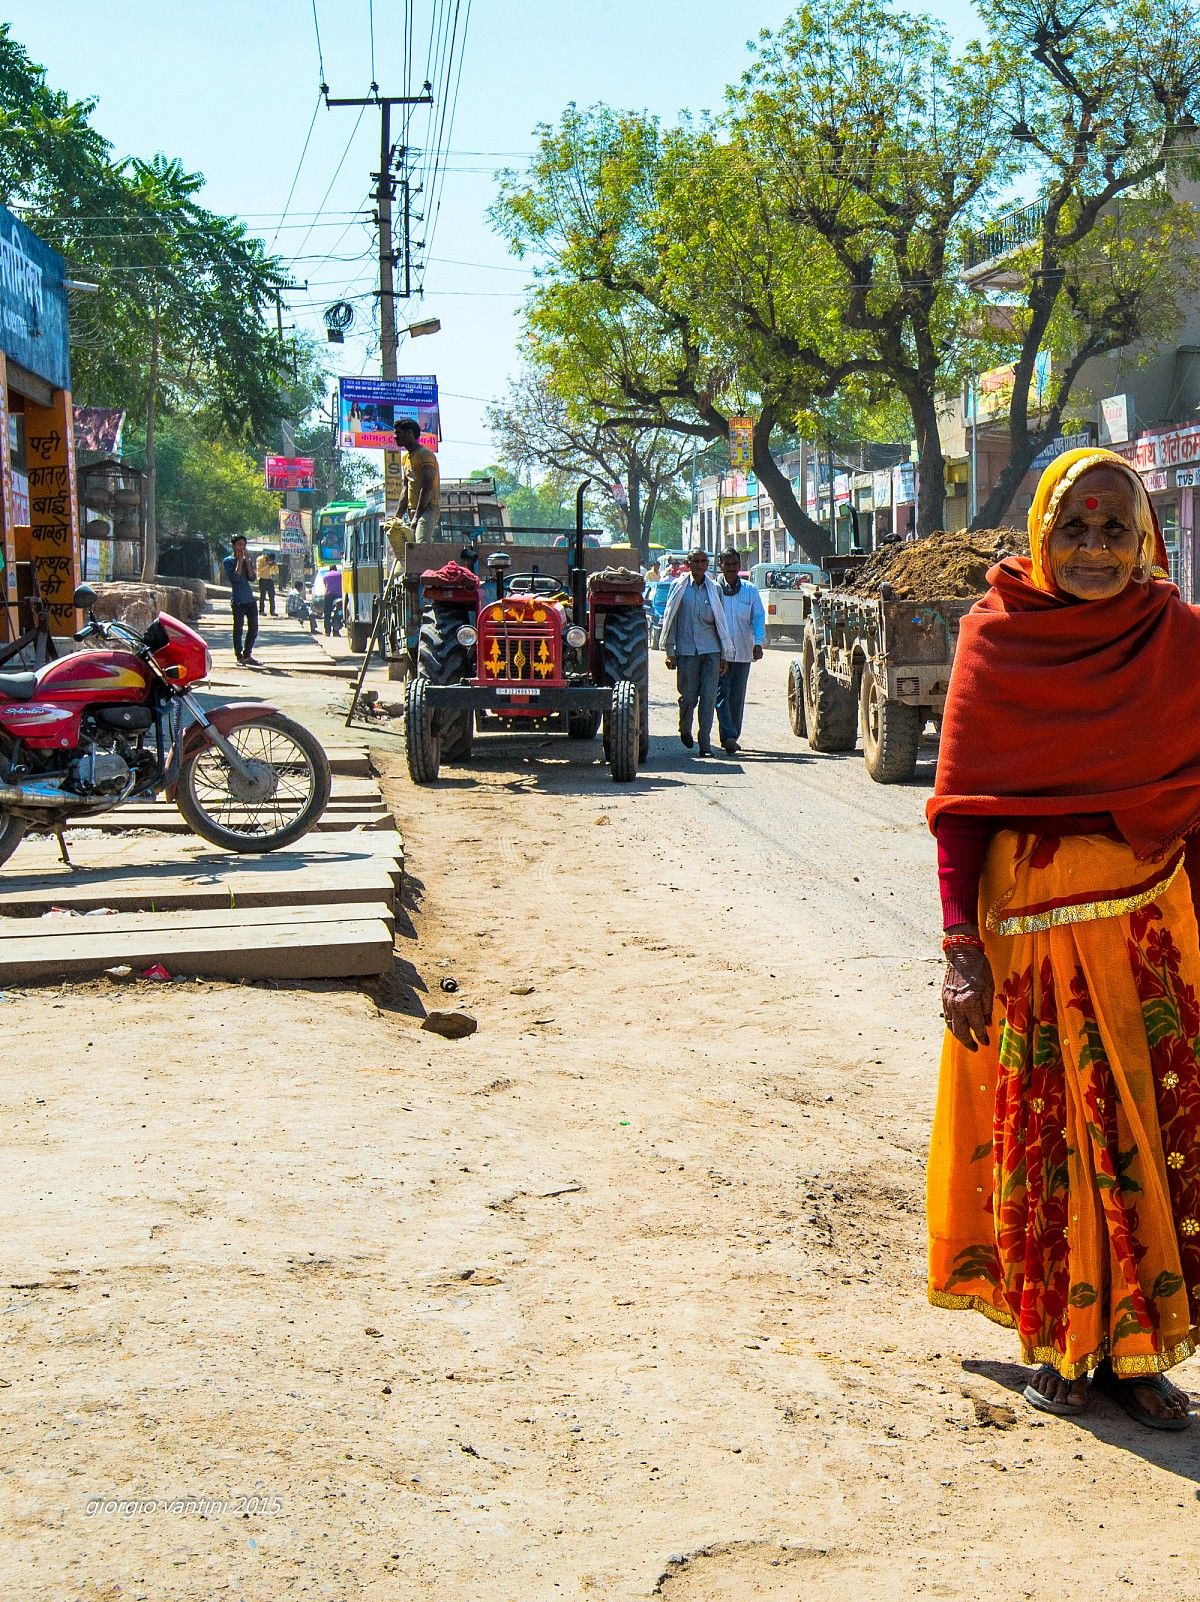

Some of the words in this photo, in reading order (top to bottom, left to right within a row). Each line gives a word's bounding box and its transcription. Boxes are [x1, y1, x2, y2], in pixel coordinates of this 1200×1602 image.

[29, 430, 61, 460] पट्टी
[1161, 434, 1181, 465] ऑटो
[1177, 472, 1194, 487] TVS
[40, 574, 66, 596] की
